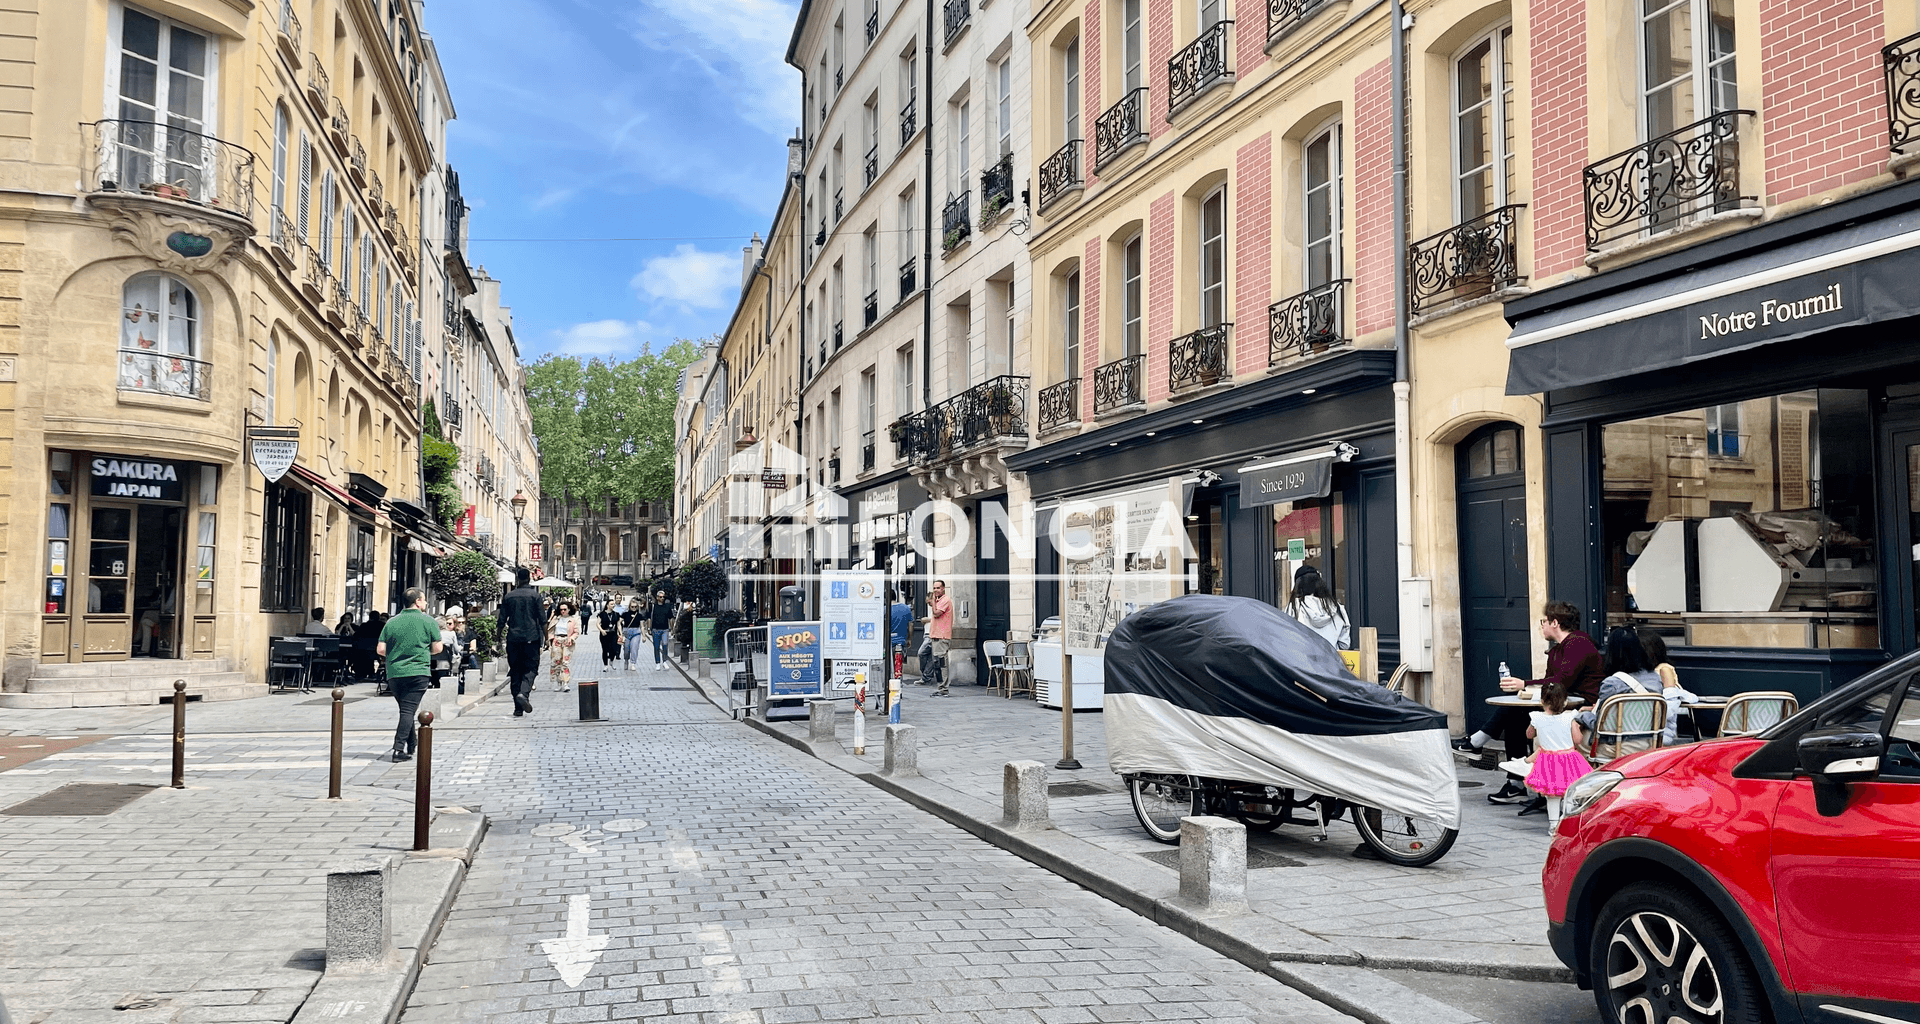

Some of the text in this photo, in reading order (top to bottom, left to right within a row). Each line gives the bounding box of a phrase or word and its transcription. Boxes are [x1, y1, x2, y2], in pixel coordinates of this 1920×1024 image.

[1700, 283, 1843, 340] Notre Fournil
[91, 459, 178, 482] SAKURA
[107, 482, 162, 498] JAPAN
[1261, 472, 1305, 494] Since 1929
[776, 631, 811, 648] STOP
